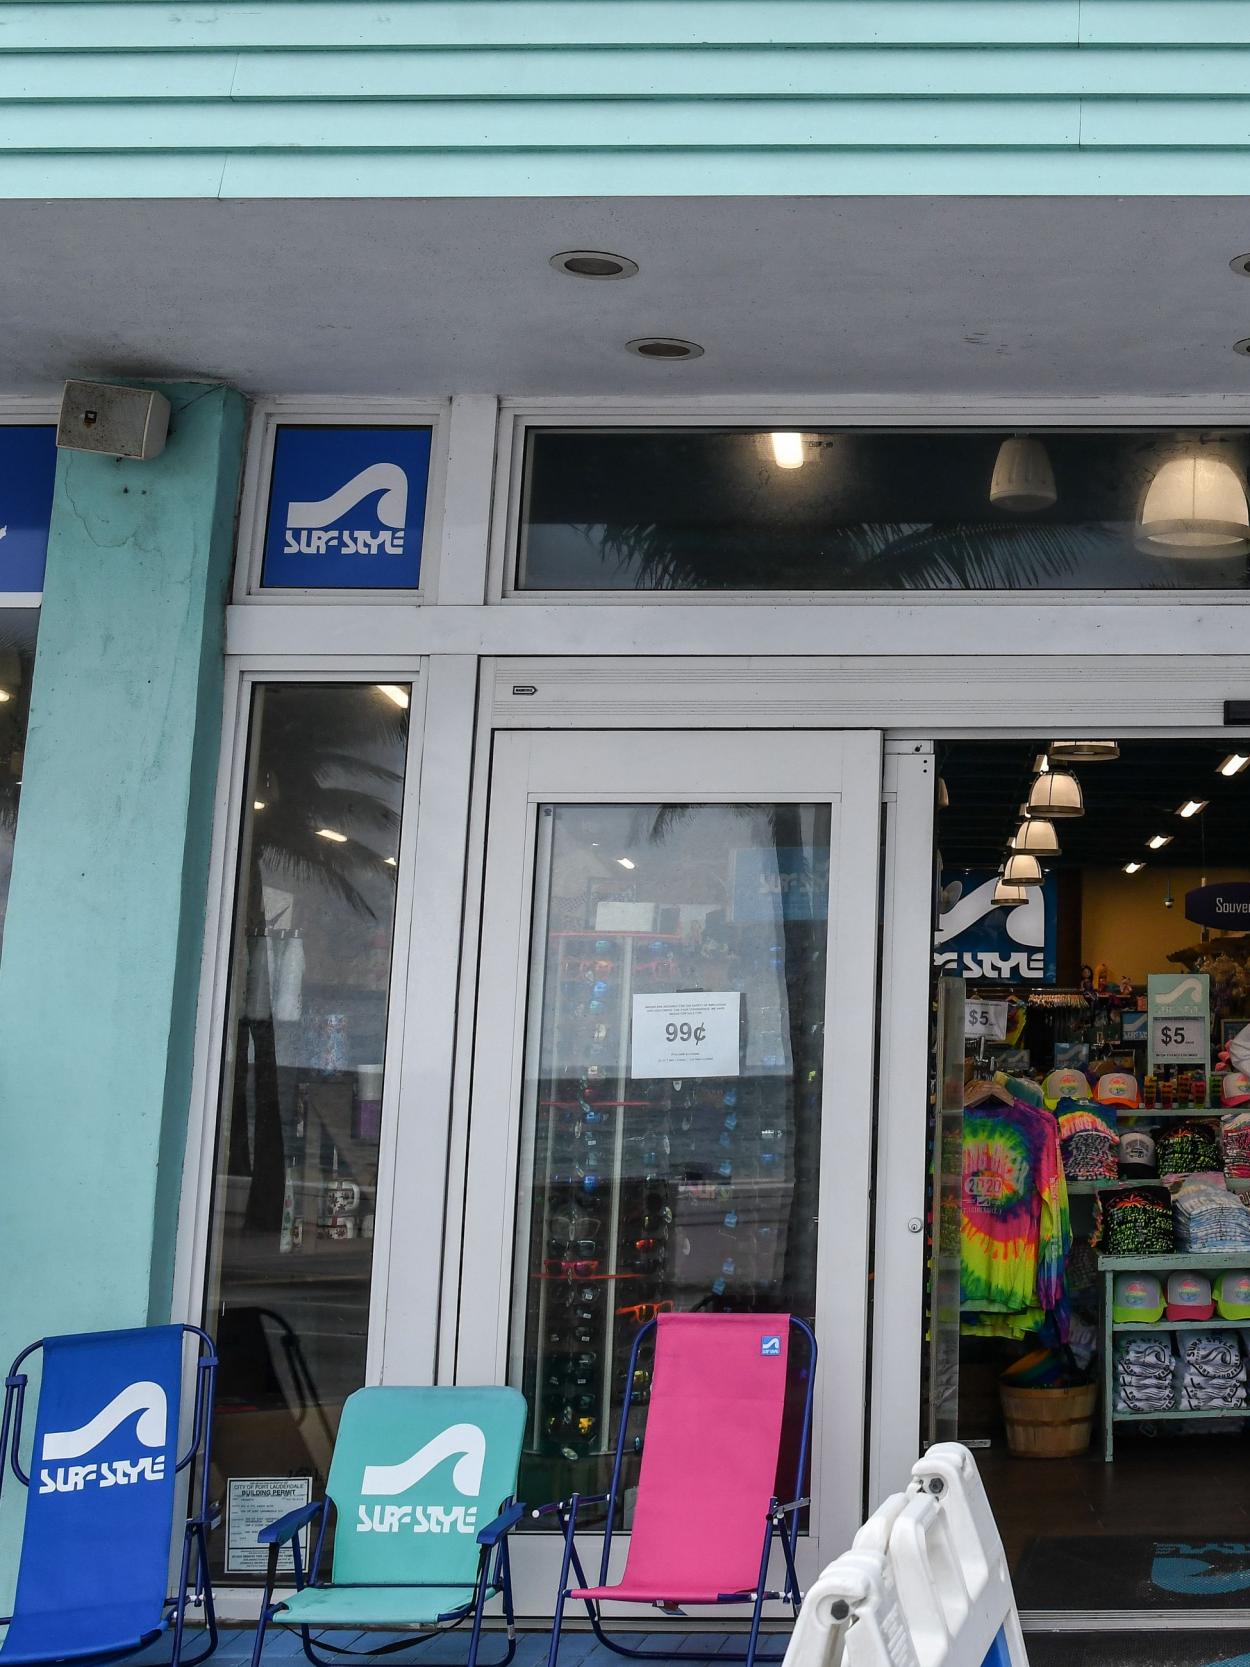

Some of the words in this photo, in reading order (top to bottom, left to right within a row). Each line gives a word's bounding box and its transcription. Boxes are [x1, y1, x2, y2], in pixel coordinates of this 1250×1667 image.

[284, 530, 339, 554] SURF
[341, 530, 404, 555] STYLE
[963, 952, 1043, 978] STYLE
[969, 1009, 989, 1026] $5
[665, 1022, 706, 1046] 99¢
[1161, 1025, 1185, 1046] $5
[39, 1464, 96, 1494] SURF
[99, 1455, 166, 1488] STYLE
[357, 1505, 412, 1533] SURF
[414, 1505, 478, 1534] STYLE
